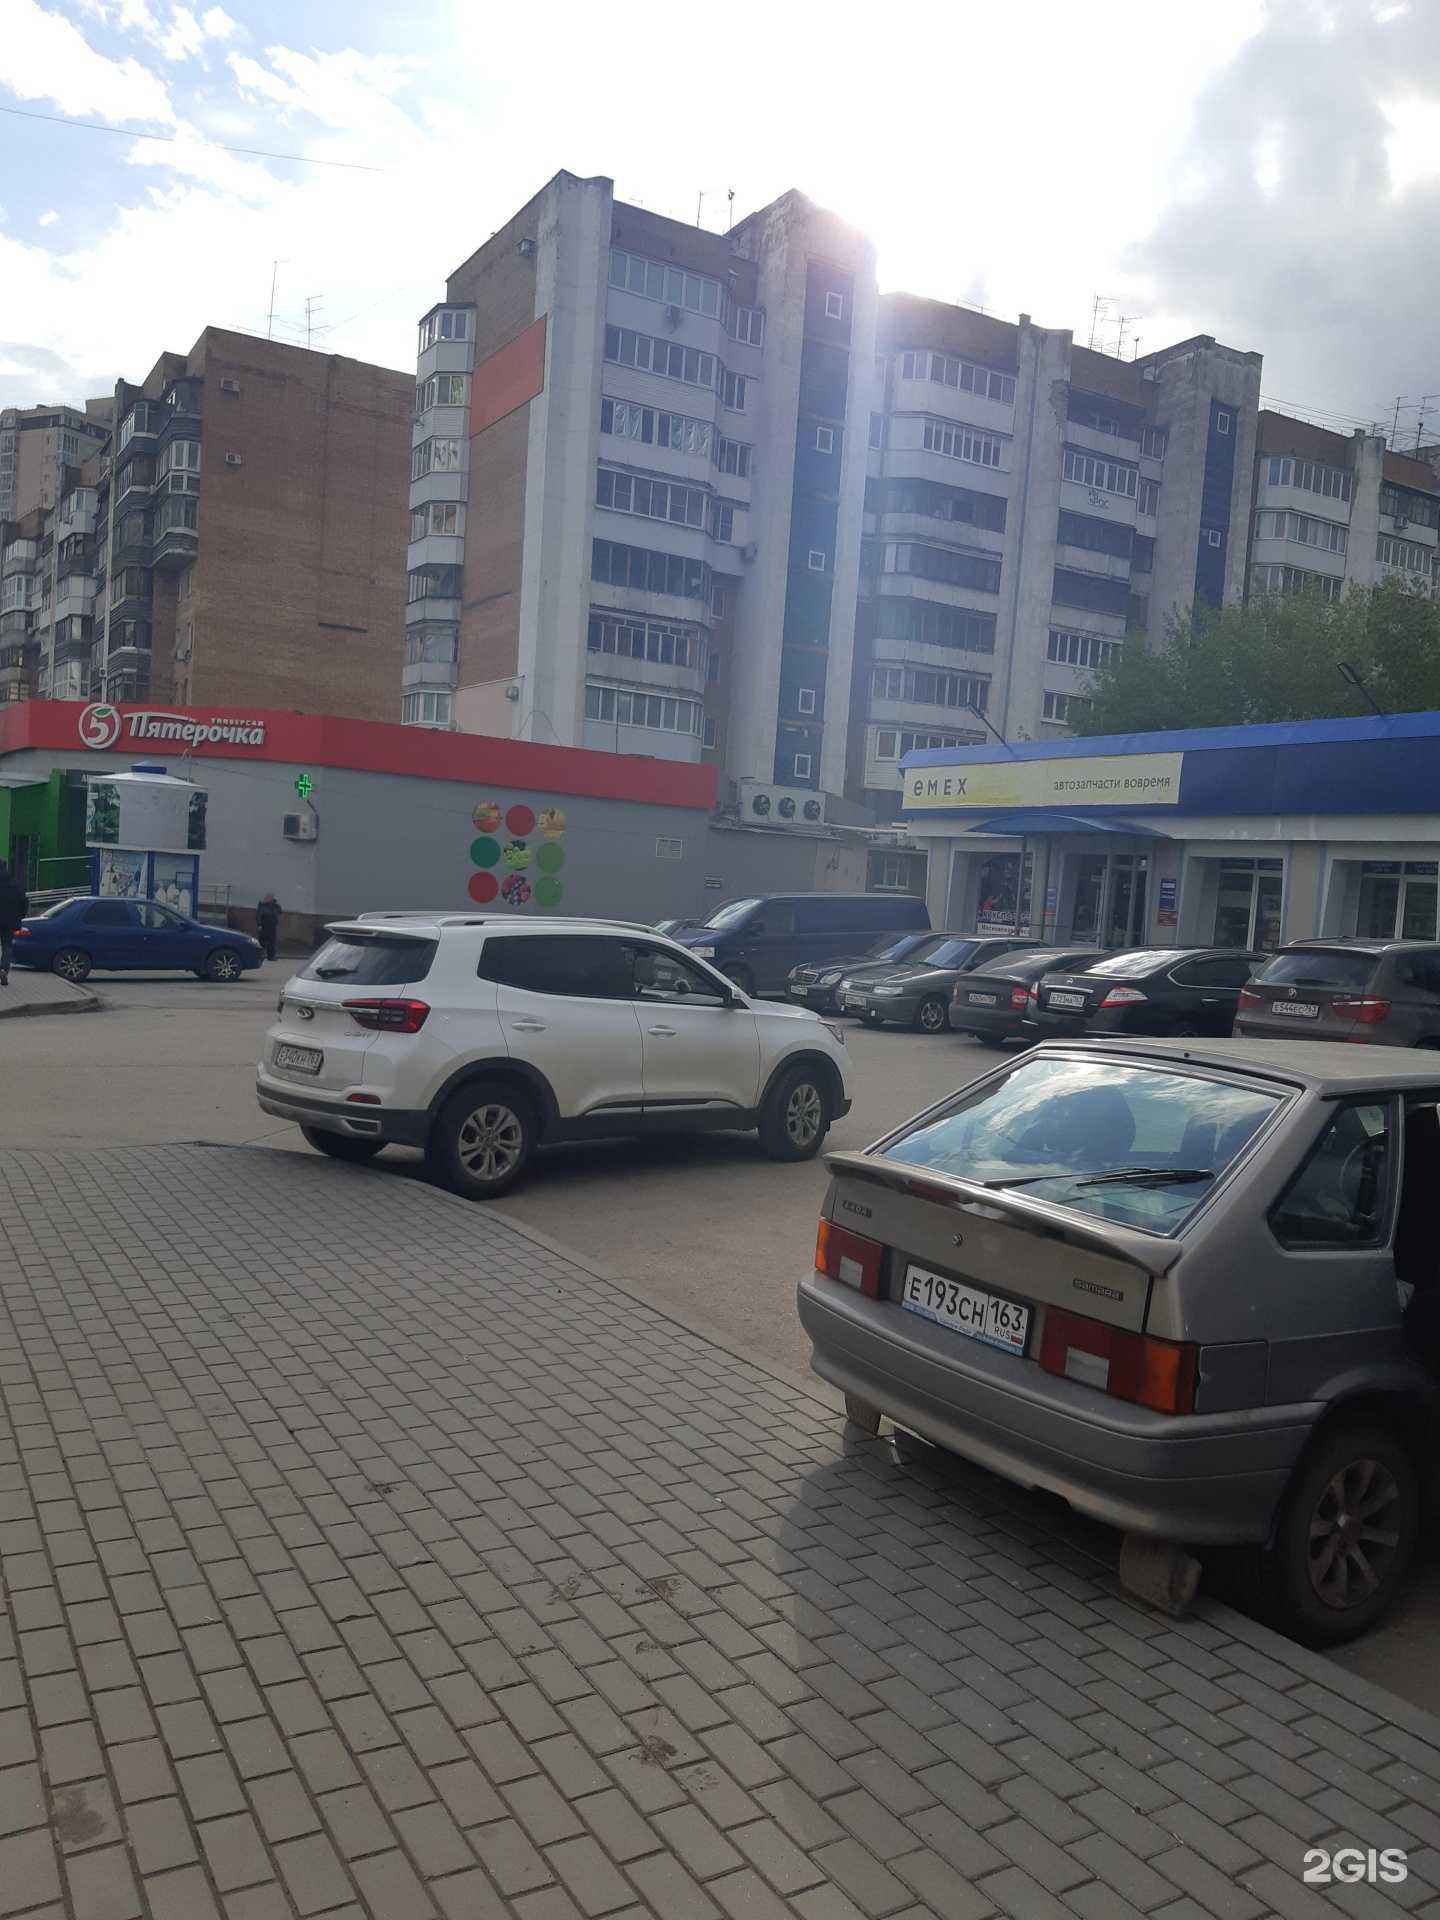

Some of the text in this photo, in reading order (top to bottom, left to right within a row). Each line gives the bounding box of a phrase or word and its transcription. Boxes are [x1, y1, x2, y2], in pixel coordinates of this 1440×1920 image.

[1053, 776, 1171, 791] автозапчасти вовремя
[909, 1276, 986, 1327] Е193СН
[990, 1299, 1023, 1331] 163
[994, 1326, 1011, 1341] RUS
